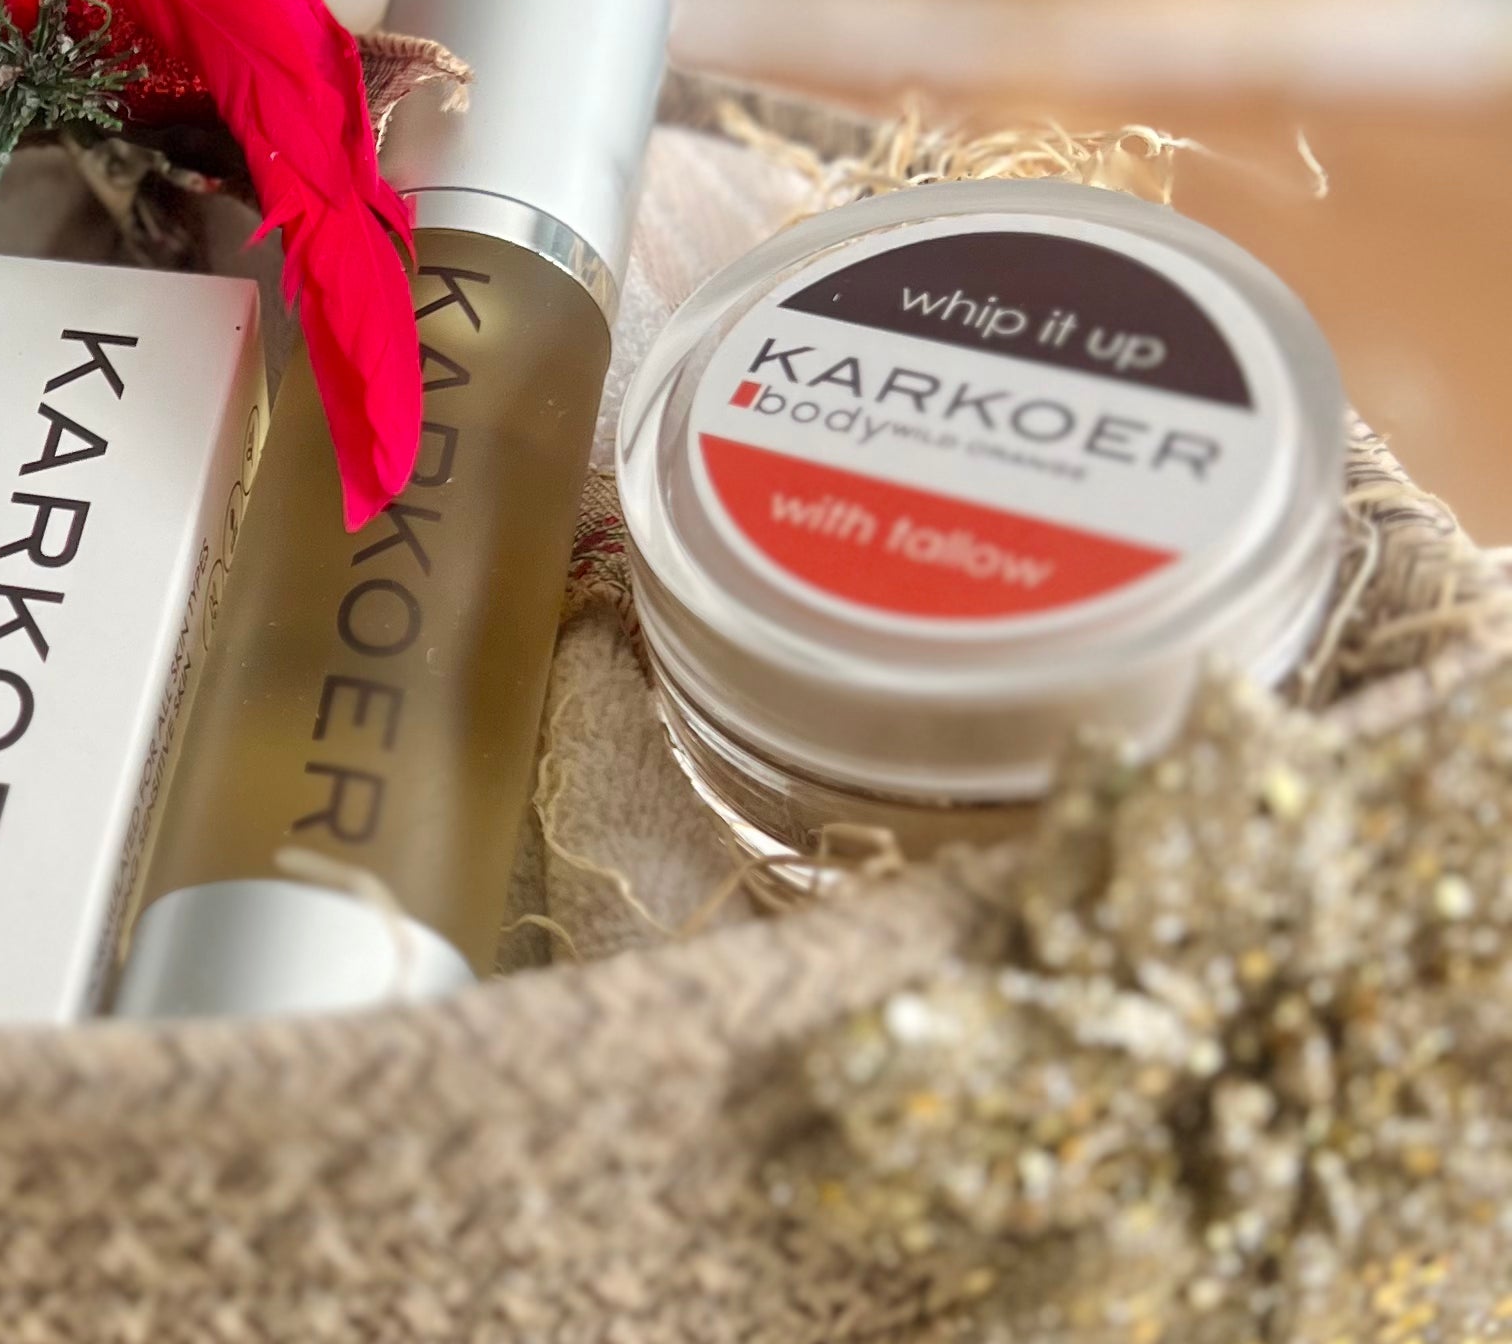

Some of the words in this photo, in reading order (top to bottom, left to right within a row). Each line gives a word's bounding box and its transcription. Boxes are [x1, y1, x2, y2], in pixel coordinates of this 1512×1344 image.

[902, 286, 1028, 339] whip
[1038, 309, 1079, 349] it
[1085, 326, 1167, 372] up
[746, 337, 1226, 483] KARKOER
[752, 384, 890, 445] body
[889, 420, 961, 450] WILD
[769, 492, 880, 547] with
[885, 514, 1060, 590] tallow
